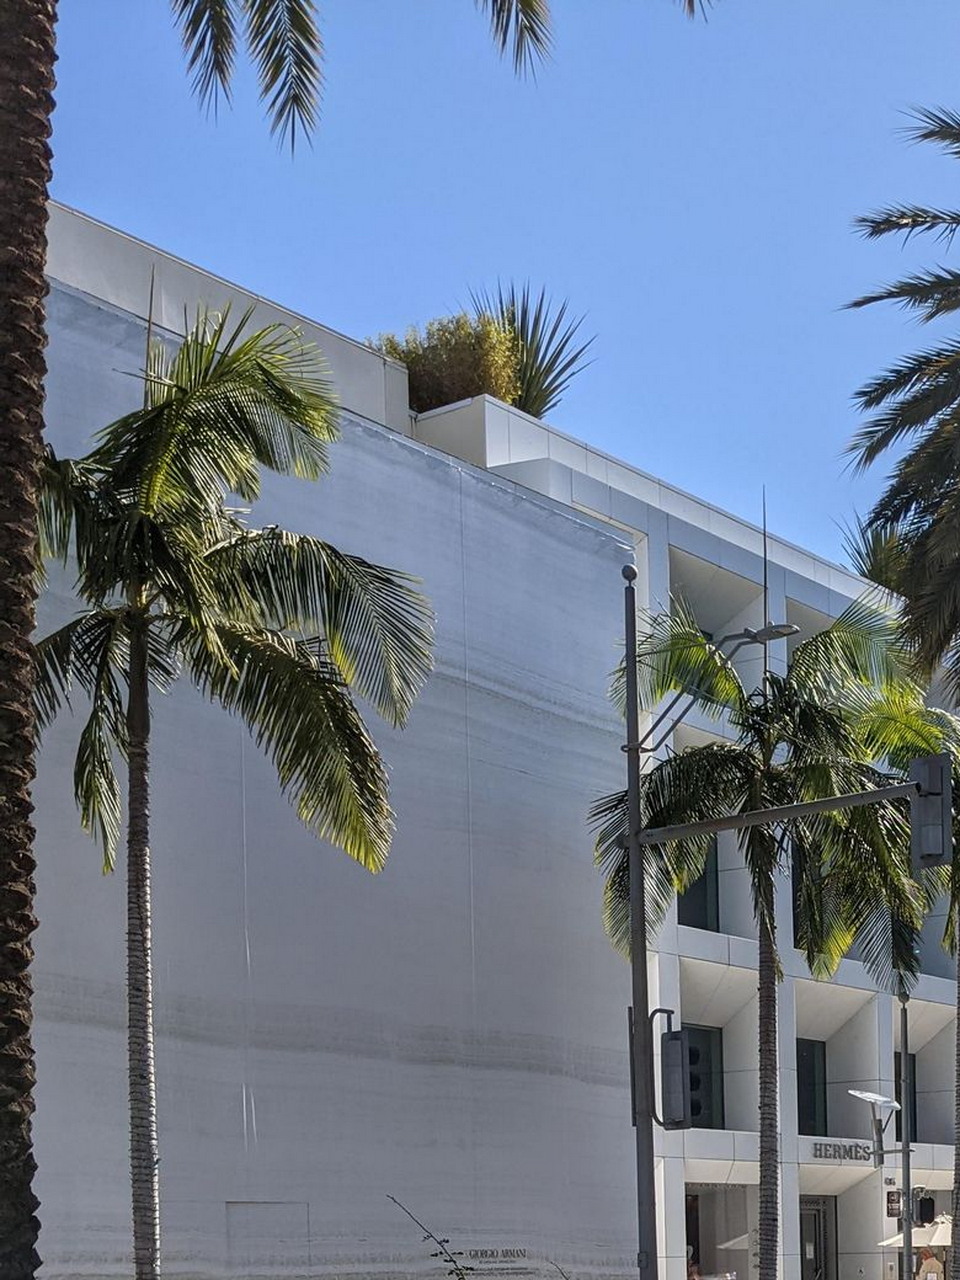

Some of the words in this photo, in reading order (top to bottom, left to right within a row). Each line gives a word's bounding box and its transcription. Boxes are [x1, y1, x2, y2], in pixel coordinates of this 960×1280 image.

[813, 1142, 871, 1161] HERMÈS
[469, 1249, 499, 1259] GIORGIO
[501, 1248, 526, 1259] ARMANI
